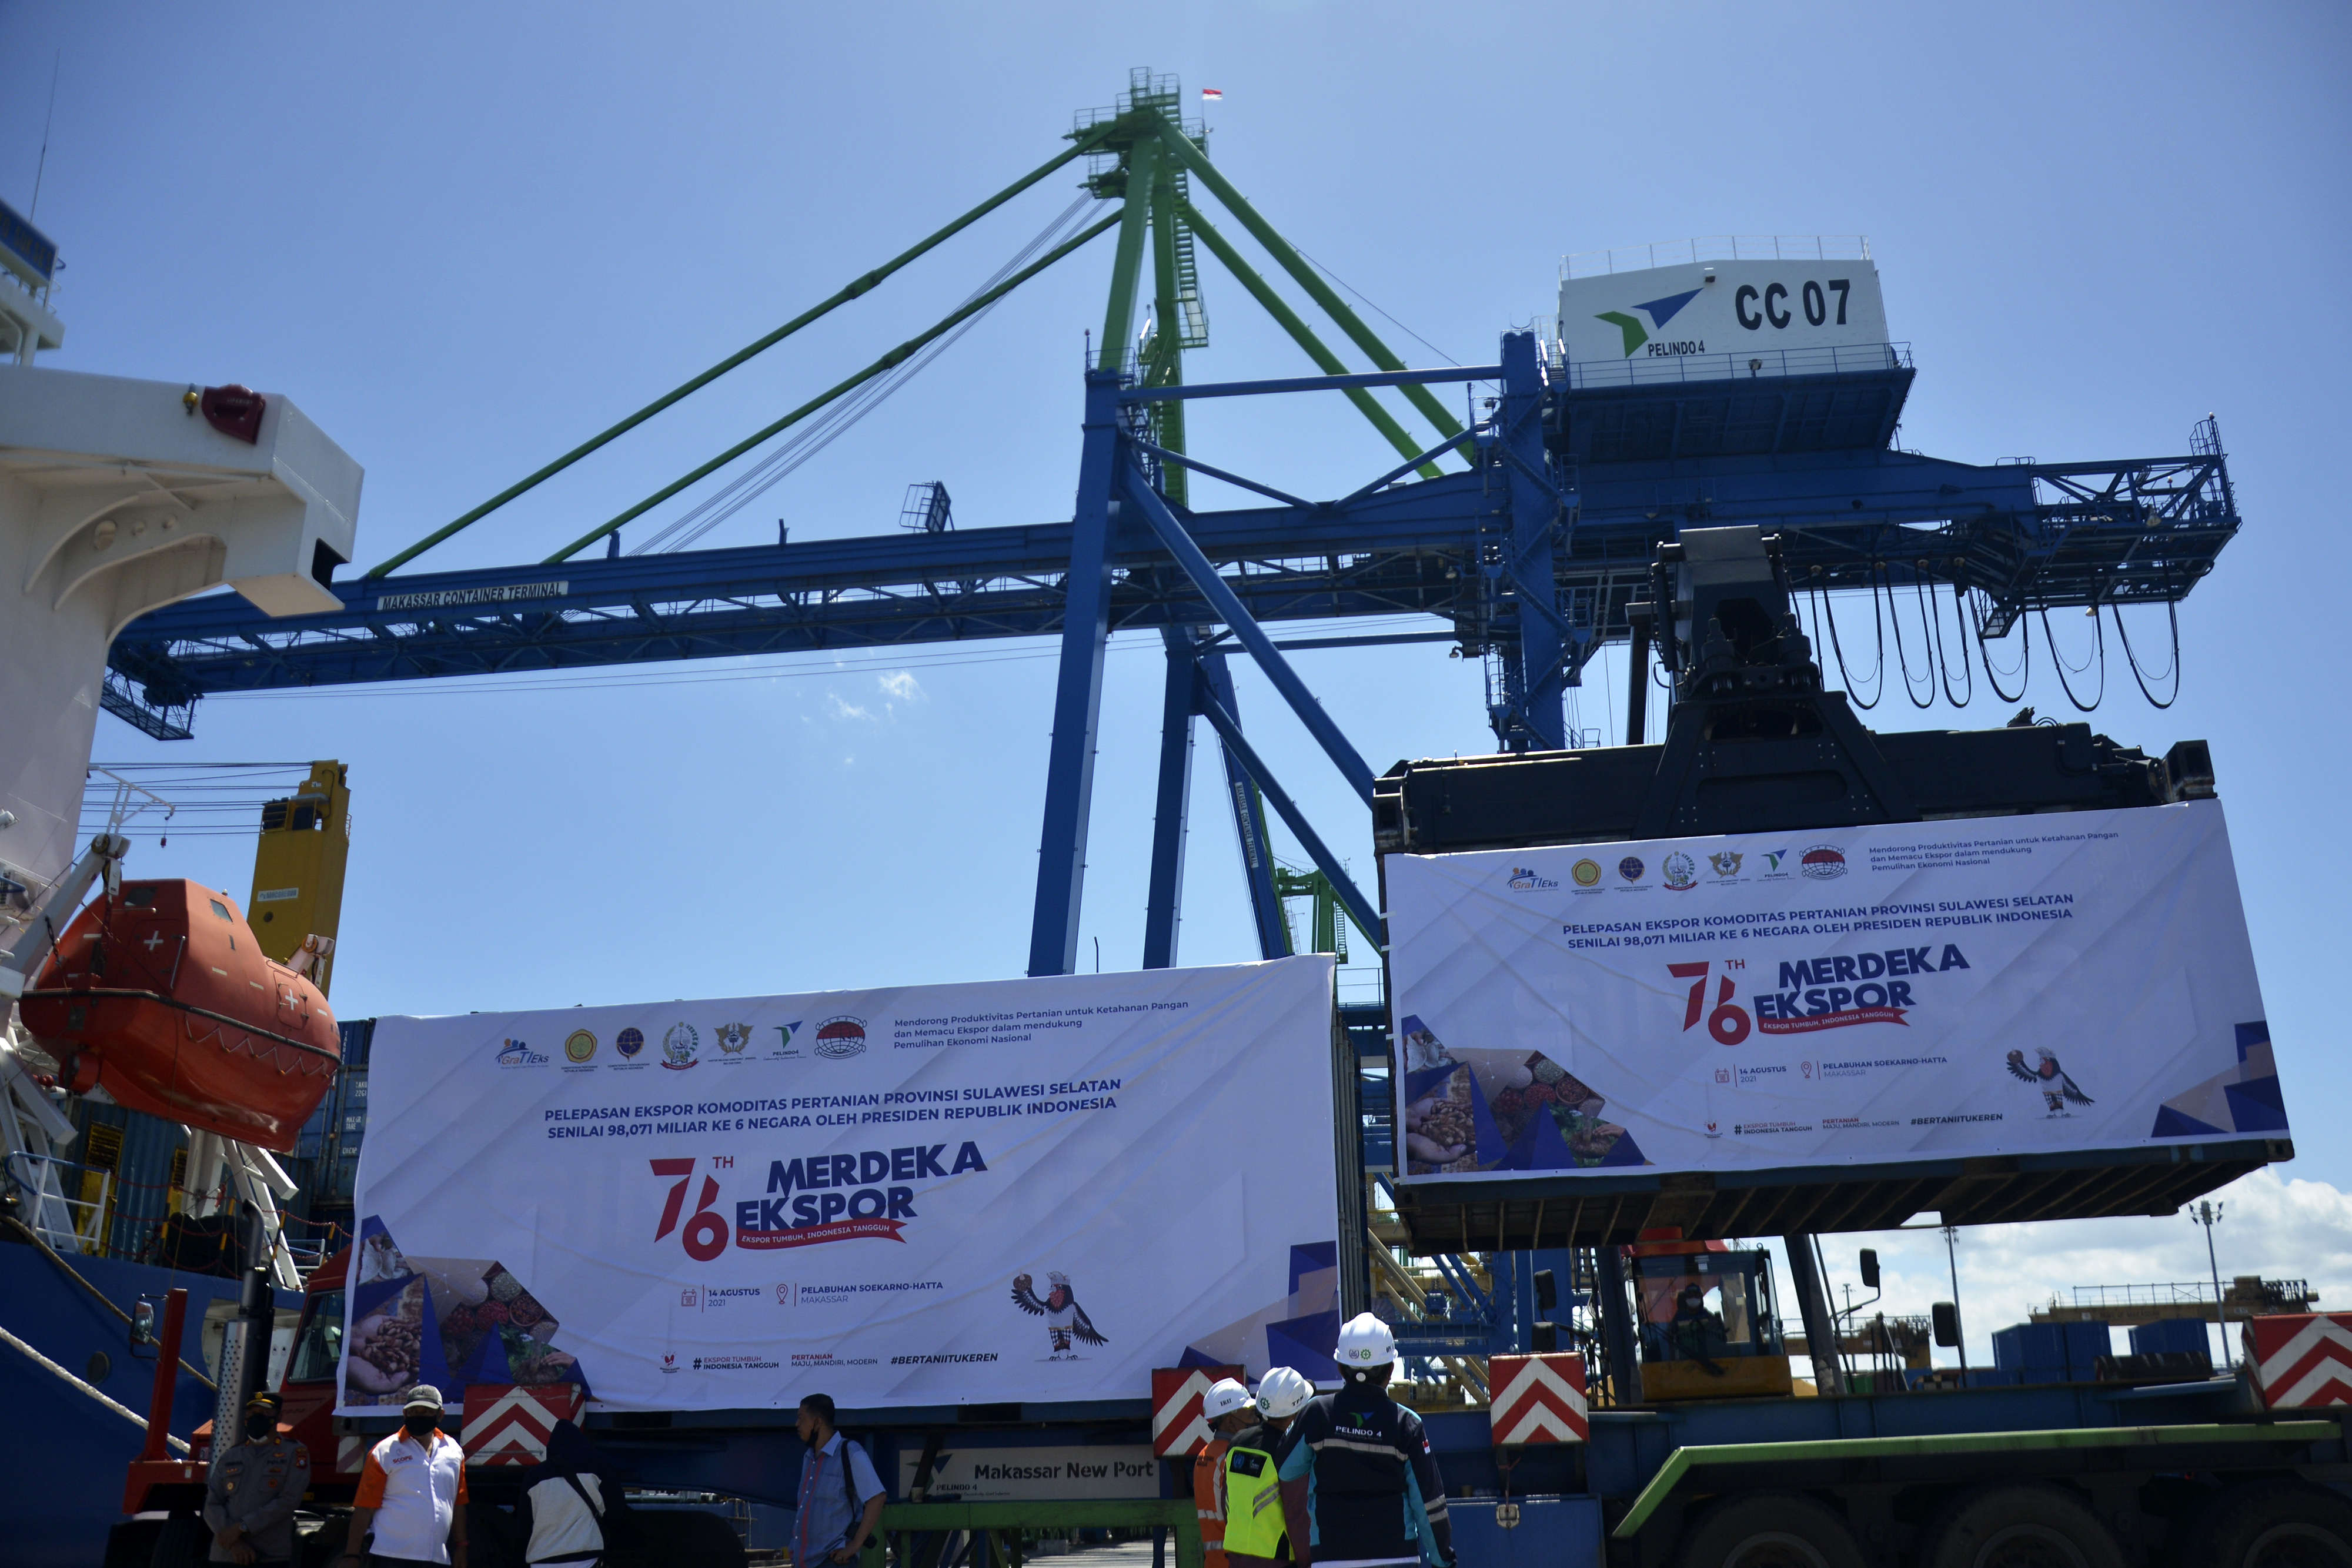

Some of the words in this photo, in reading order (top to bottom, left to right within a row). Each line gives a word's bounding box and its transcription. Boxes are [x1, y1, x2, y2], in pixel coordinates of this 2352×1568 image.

[1735, 284, 1791, 330] CC
[1802, 279, 1850, 327] 07
[1648, 340, 1696, 357] PELINDO
[1698, 340, 1705, 353] 4
[383, 593, 440, 610] MAKASSAR
[443, 588, 505, 604] CONTAINER
[508, 583, 562, 599] TERMINAL
[1238, 785, 1247, 811] MAKASSAR
[1242, 813, 1252, 839] CONTAINER
[1248, 840, 1258, 865] TERMINAL
[1918, 842, 1972, 850] Produktivitas
[1563, 922, 1641, 934] PELEPASAN
[1646, 918, 1699, 930] EKSPOR
[1704, 912, 1785, 925] KOMODITAS
[1790, 907, 1867, 920] PERTANIAN
[1871, 903, 1935, 915] PROVINSI
[1939, 898, 2009, 911] SULAWESI
[2013, 894, 2073, 907] SELATAN
[1568, 937, 1619, 948] SENILAI
[1624, 935, 1665, 947] 98,071
[1669, 931, 1715, 943] MILIAR
[1720, 930, 1737, 940] KE
[1741, 929, 1749, 937] 6
[1753, 925, 1810, 937] NEGARA
[1813, 923, 1849, 933] OLEH
[1854, 918, 1921, 931] PRESIDEN
[1925, 914, 1992, 927] REPUBLIK
[1996, 909, 2072, 922] INDONESIA
[1725, 959, 1745, 970] TH
[1779, 943, 1970, 990] MERDEKA
[1666, 961, 1751, 1045] 76
[1753, 980, 1916, 1019] EKSPOR
[895, 1018, 948, 1027] Mendorong
[951, 1013, 1013, 1023] Produktivitas
[1017, 1009, 1062, 1019] Pertanian
[1065, 1007, 1093, 1015] untuk
[1097, 1005, 1148, 1014] Ketahanan
[1024, 1020, 1082, 1029] mendukung
[1791, 1020, 1820, 1029] TUMBUH,
[1822, 1014, 1859, 1025] INDONESIA
[894, 1039, 944, 1048] Pemulihan
[947, 1036, 988, 1045] Ekonomi
[991, 1034, 1031, 1043] Nasional
[1823, 1061, 1872, 1069] PELABUHAN
[1875, 1057, 1947, 1066] SOEKARNO-HATTA
[545, 1107, 630, 1121] PELEPASAN
[635, 1105, 693, 1117] EKSPOR
[698, 1099, 787, 1114] KOMODITAS
[792, 1094, 878, 1109] PERTANIAN
[884, 1090, 958, 1104] PROVINSI
[963, 1085, 1044, 1100] SULAWESI
[1050, 1079, 1120, 1094] SELATAN
[548, 1126, 603, 1138] SENILAI
[608, 1124, 652, 1137] 98,071
[657, 1121, 707, 1134] MILIAR
[712, 1120, 731, 1131] KE
[736, 1119, 743, 1129] 6
[749, 1116, 811, 1129] NEGARA
[816, 1114, 856, 1125] OLEH
[862, 1109, 938, 1124] PRESIDEN
[945, 1104, 1022, 1119] REPUBLIK
[1027, 1097, 1116, 1114] INDONESIA
[1911, 1114, 2002, 1125] #BERTANIITUKEREN
[1735, 1125, 1742, 1135] #
[713, 1156, 733, 1168] TH
[767, 1141, 987, 1199] MERDEKA
[649, 1157, 729, 1261] 76
[736, 1186, 917, 1231] EKSPOR
[742, 1235, 770, 1243] EKSPOR
[771, 1233, 806, 1243] TUMBUH,
[807, 1226, 850, 1239] INDONESIA
[853, 1224, 890, 1233] TANGGUH
[801, 1285, 856, 1293] PELABUHAN
[860, 1282, 943, 1292] SOEKARNO-HATTA
[693, 1358, 701, 1370] #
[891, 1353, 998, 1364] #BERTANIITUKEREN
[1336, 1426, 1373, 1436] PELINDO
[393, 1455, 413, 1463] SCOPE
[974, 1463, 1061, 1479] Makassar
[1067, 1462, 1107, 1478] New
[1114, 1461, 1154, 1477] Port
